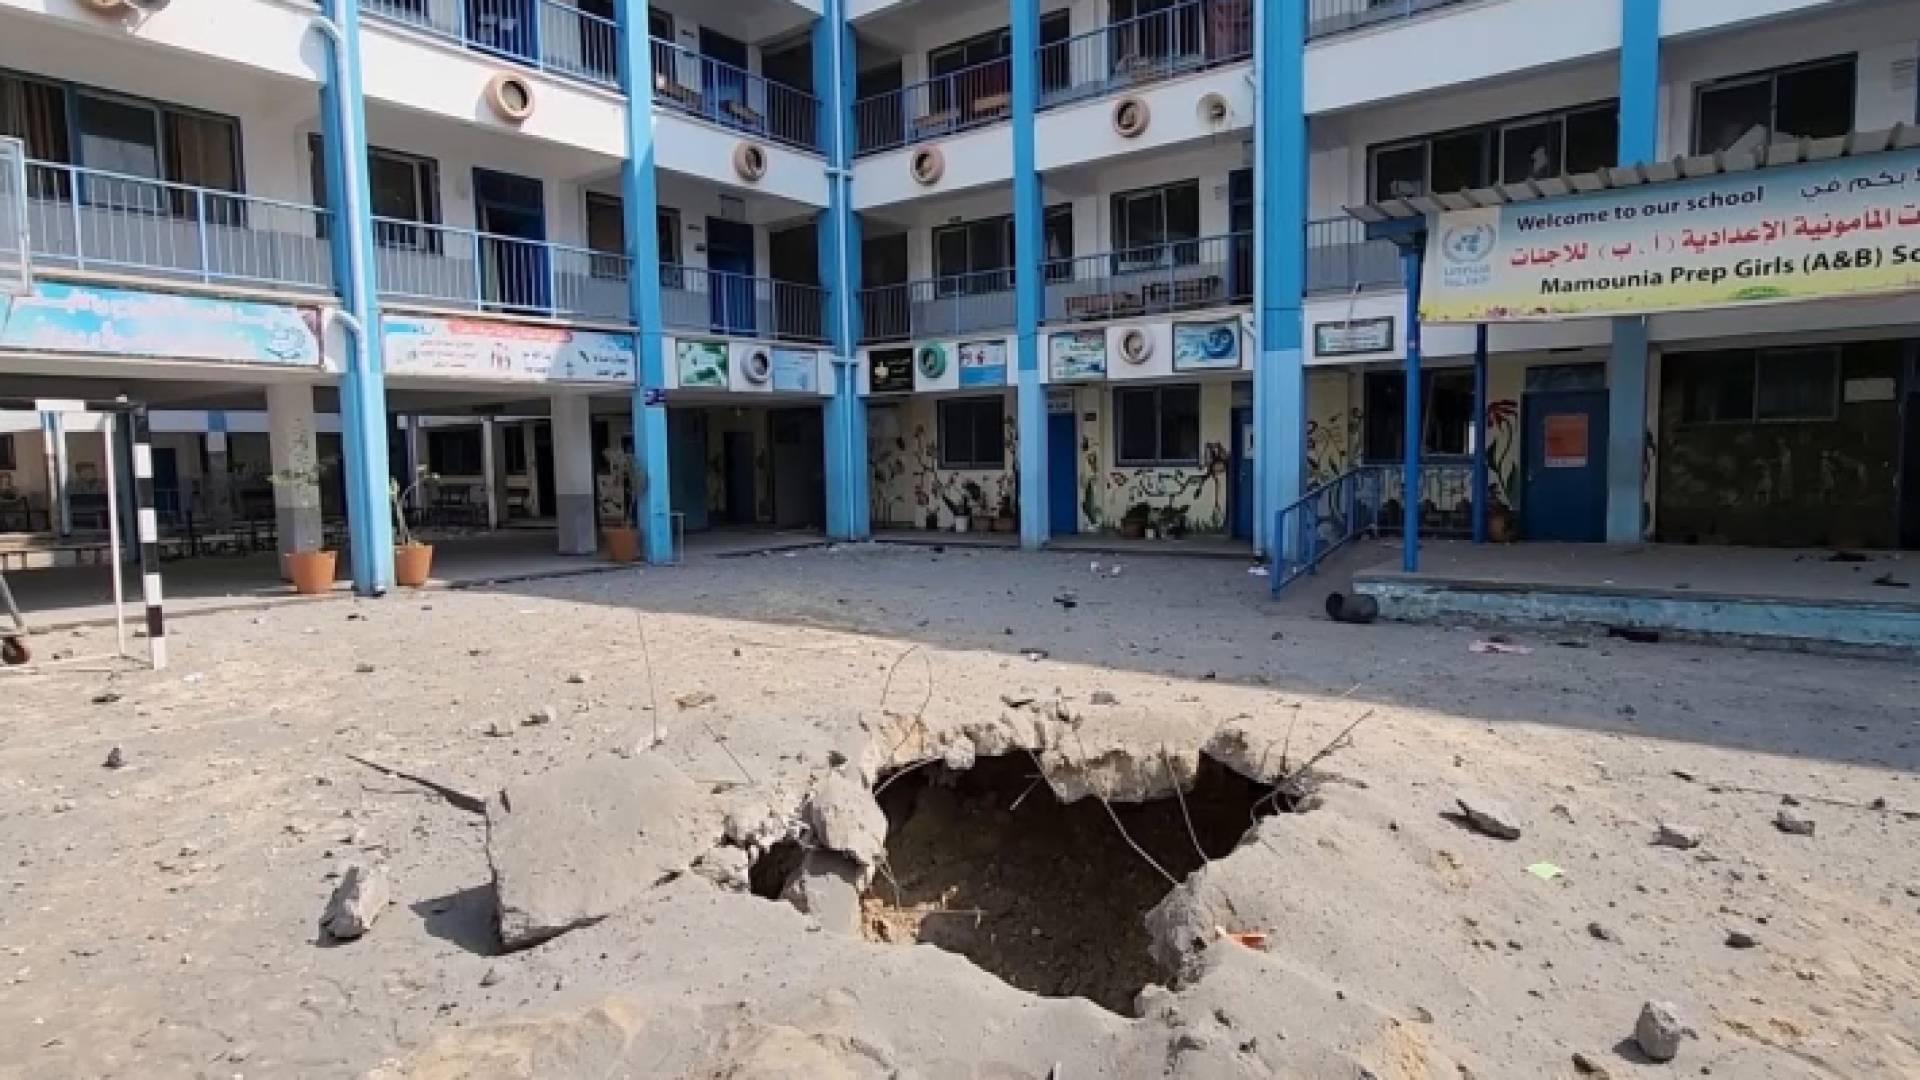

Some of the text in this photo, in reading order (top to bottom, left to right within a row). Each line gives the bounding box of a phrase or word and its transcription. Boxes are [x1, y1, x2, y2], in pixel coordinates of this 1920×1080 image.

[1516, 186, 1764, 232] Welcome to our school
[1800, 177, 1841, 202] في
[1540, 269, 1664, 295] Mamounia
[1671, 262, 1728, 288] Prep
[1734, 256, 1794, 278] Girls
[1803, 246, 1883, 275] (A&B)
